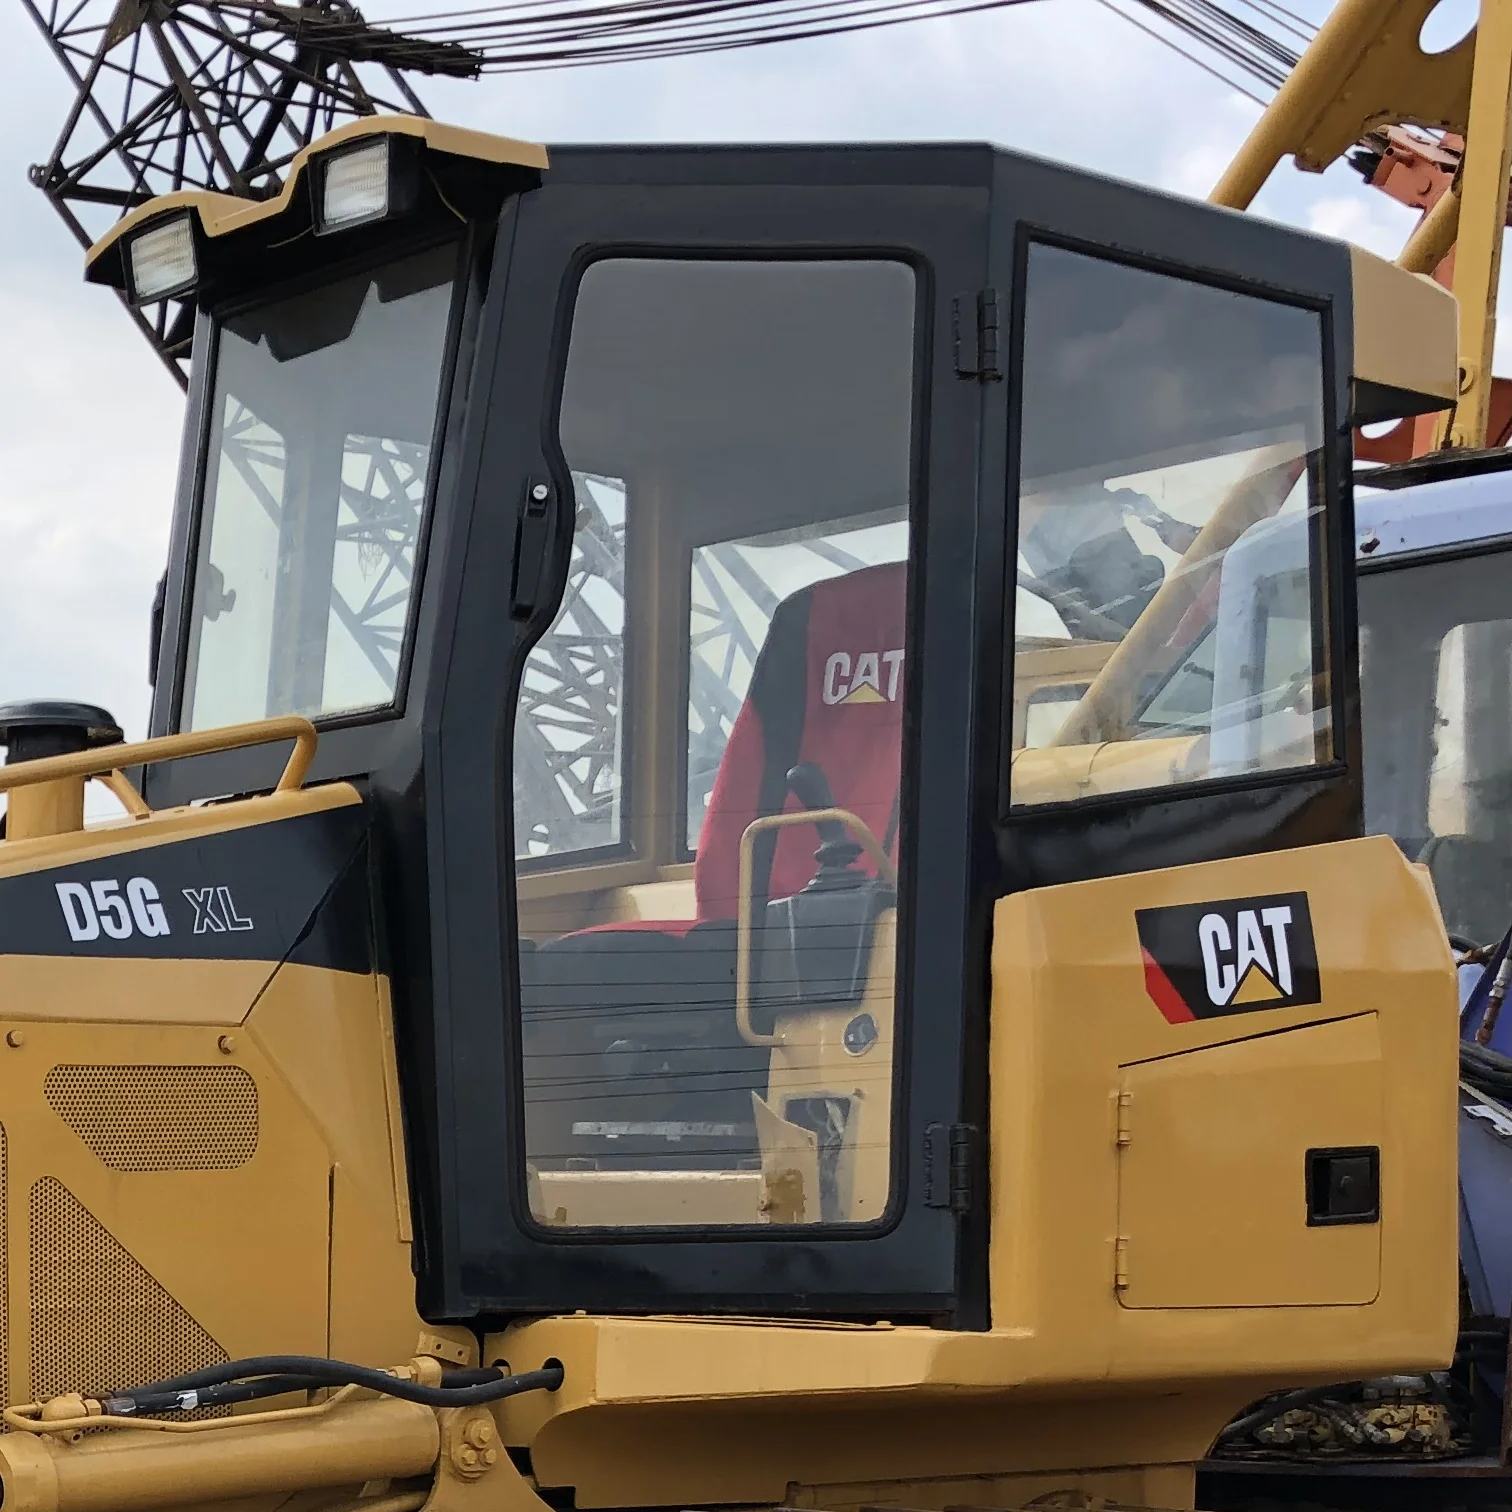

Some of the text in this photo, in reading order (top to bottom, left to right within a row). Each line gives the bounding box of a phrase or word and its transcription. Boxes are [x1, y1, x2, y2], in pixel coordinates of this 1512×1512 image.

[822, 649, 906, 705] CAT
[55, 877, 254, 942] D5G XL
[1198, 905, 1293, 1007] CAT
